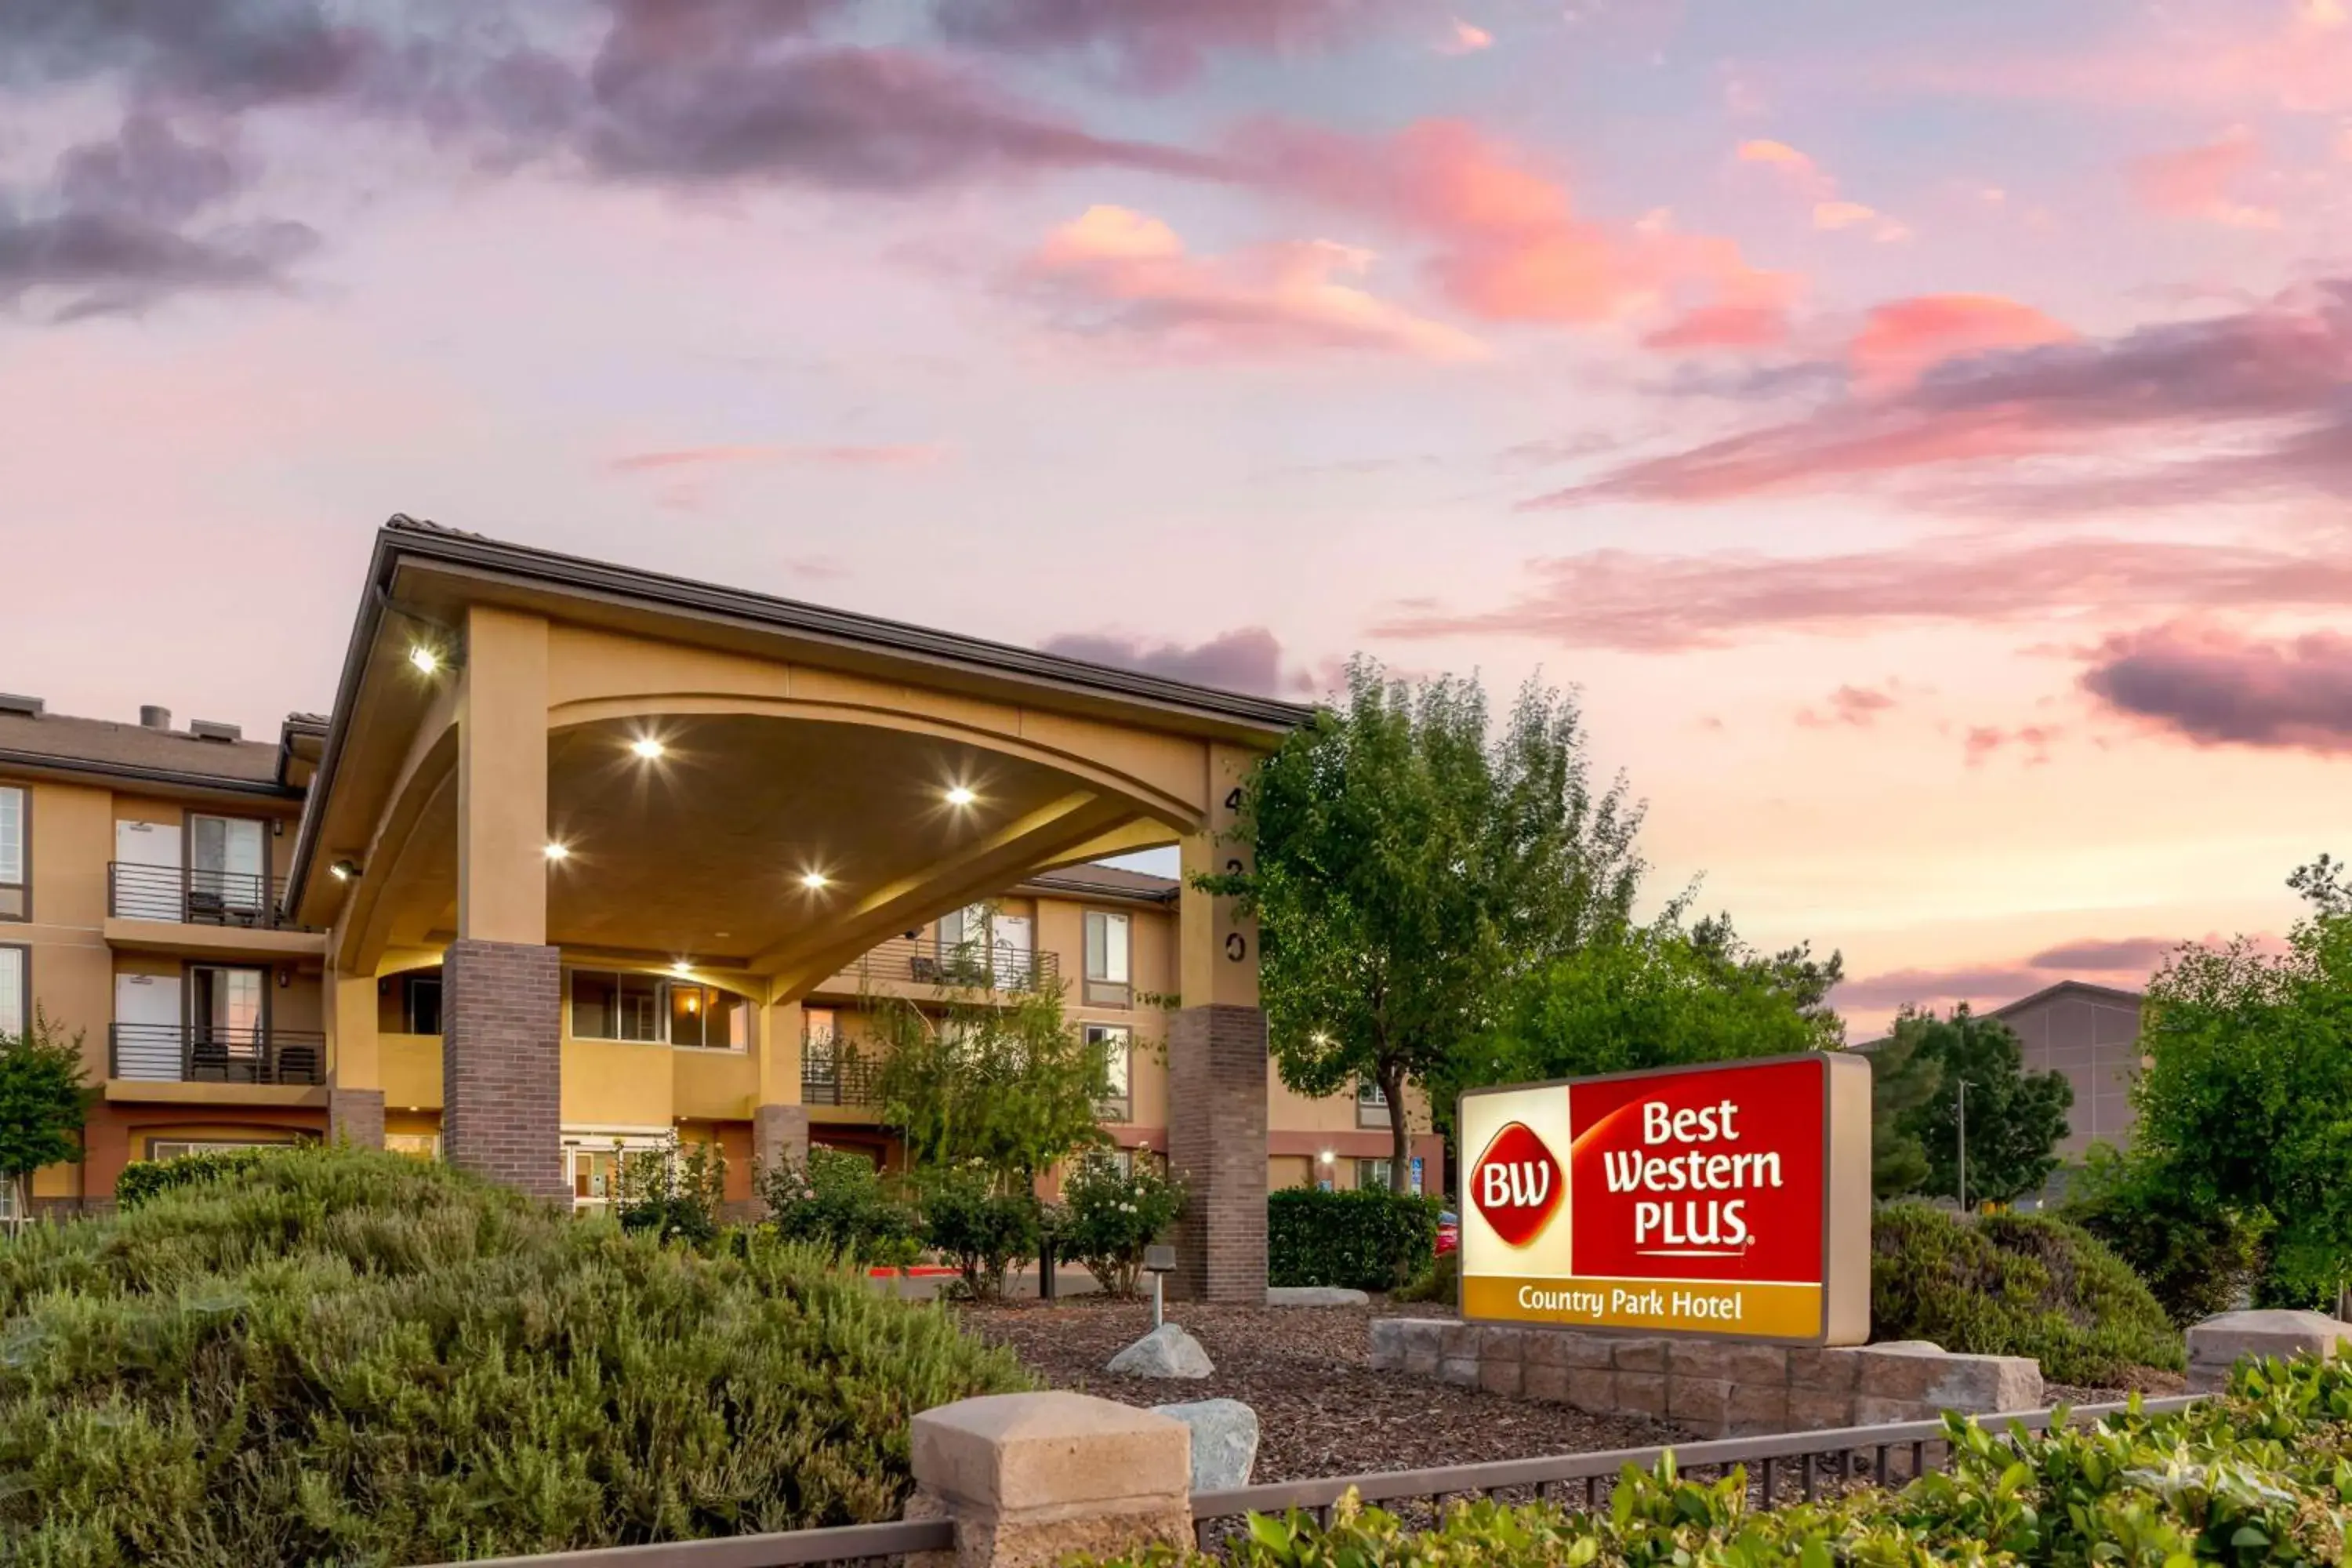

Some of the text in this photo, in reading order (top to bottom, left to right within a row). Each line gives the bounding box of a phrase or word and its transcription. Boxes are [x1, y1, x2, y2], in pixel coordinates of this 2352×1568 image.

[1642, 1099, 1739, 1145] Best
[1483, 1160, 1549, 1207] BW
[1604, 1151, 1783, 1192] Western
[1635, 1200, 1748, 1244] PLUS
[1518, 1285, 1742, 1319] Country Park Hotel
